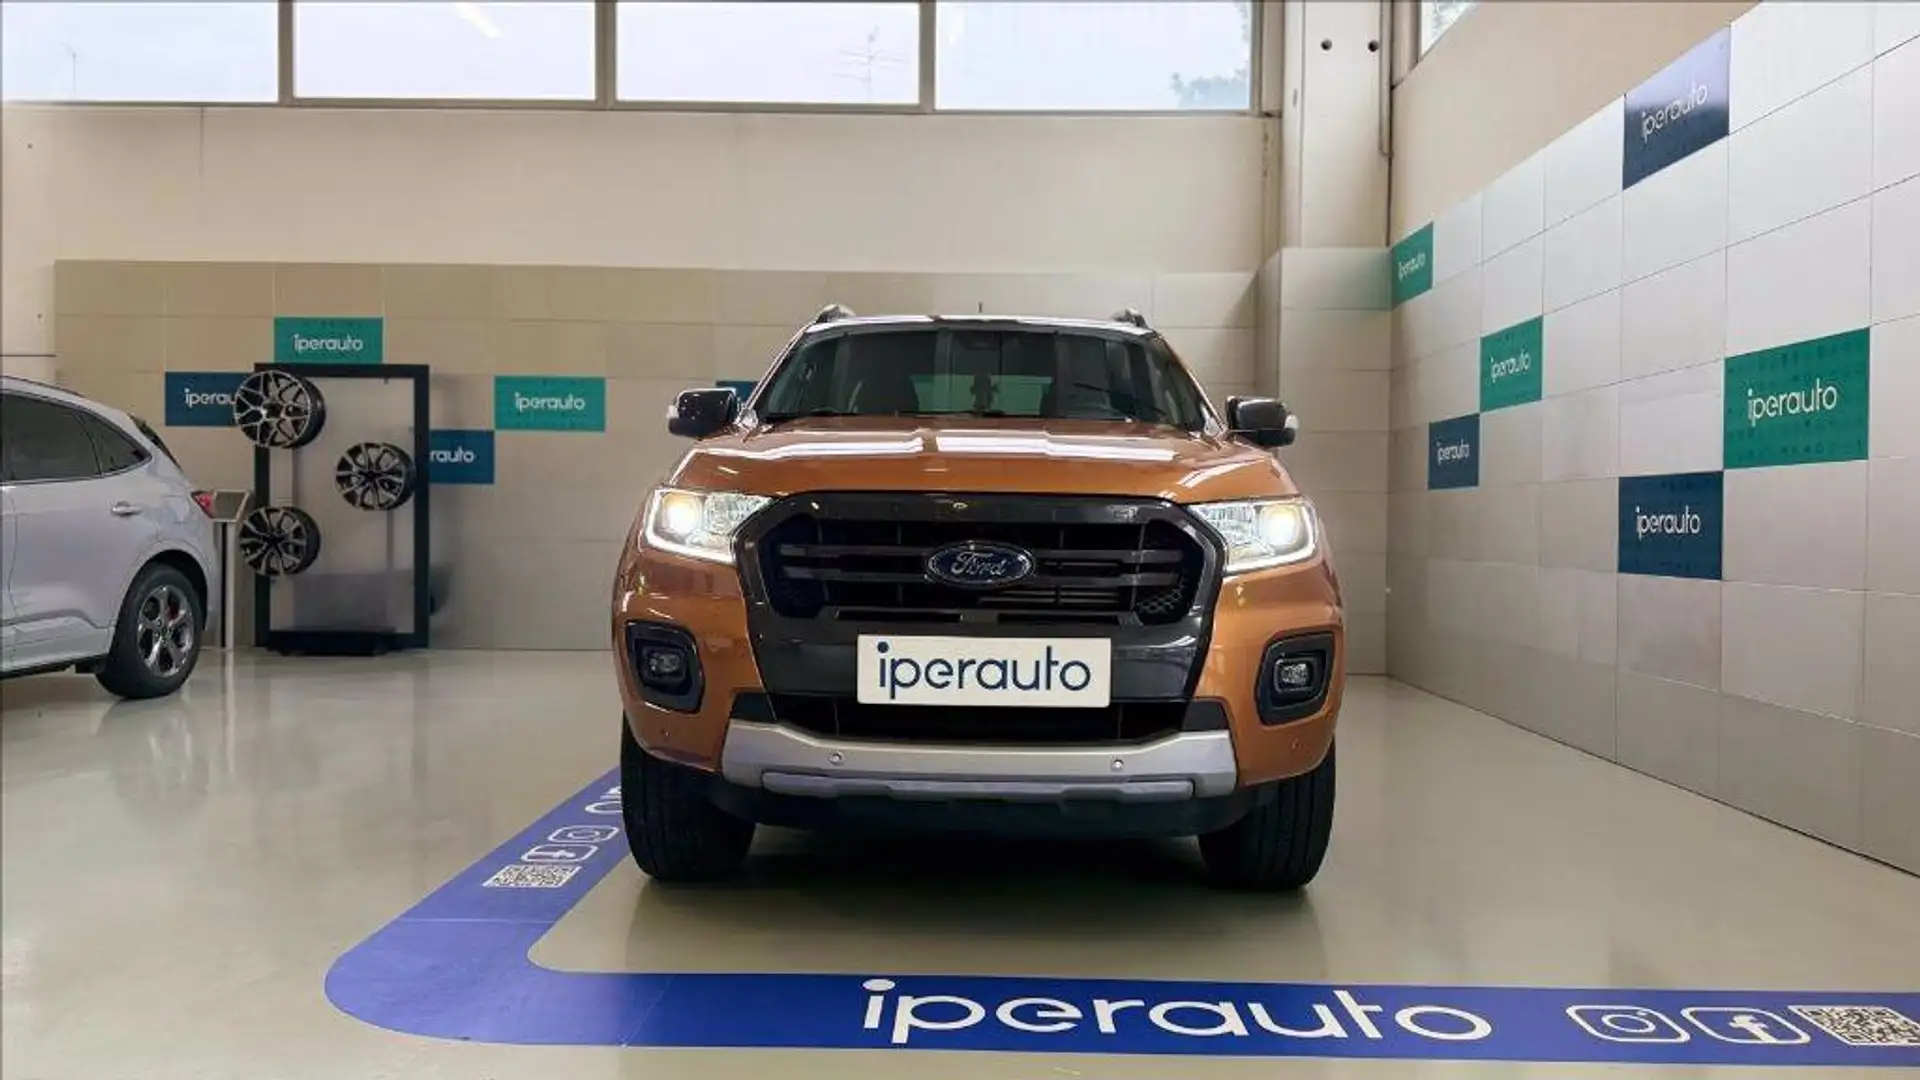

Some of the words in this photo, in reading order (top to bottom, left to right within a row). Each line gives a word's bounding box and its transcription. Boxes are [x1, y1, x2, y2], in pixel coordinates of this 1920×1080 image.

[1642, 82, 1708, 142] iperauto
[1398, 252, 1425, 281] iperauto
[294, 333, 363, 353] iperauto
[1490, 350, 1531, 384] iperauto
[184, 387, 237, 408] iperau
[515, 393, 586, 413] iperauto
[1747, 378, 1837, 427] iperauto
[430, 445, 475, 463] rauto
[1437, 439, 1469, 464] iperauto
[1636, 506, 1700, 539] iperauto
[952, 550, 1009, 576] Ford
[877, 641, 1091, 700] iperauto
[861, 978, 1492, 1045] iperauto
